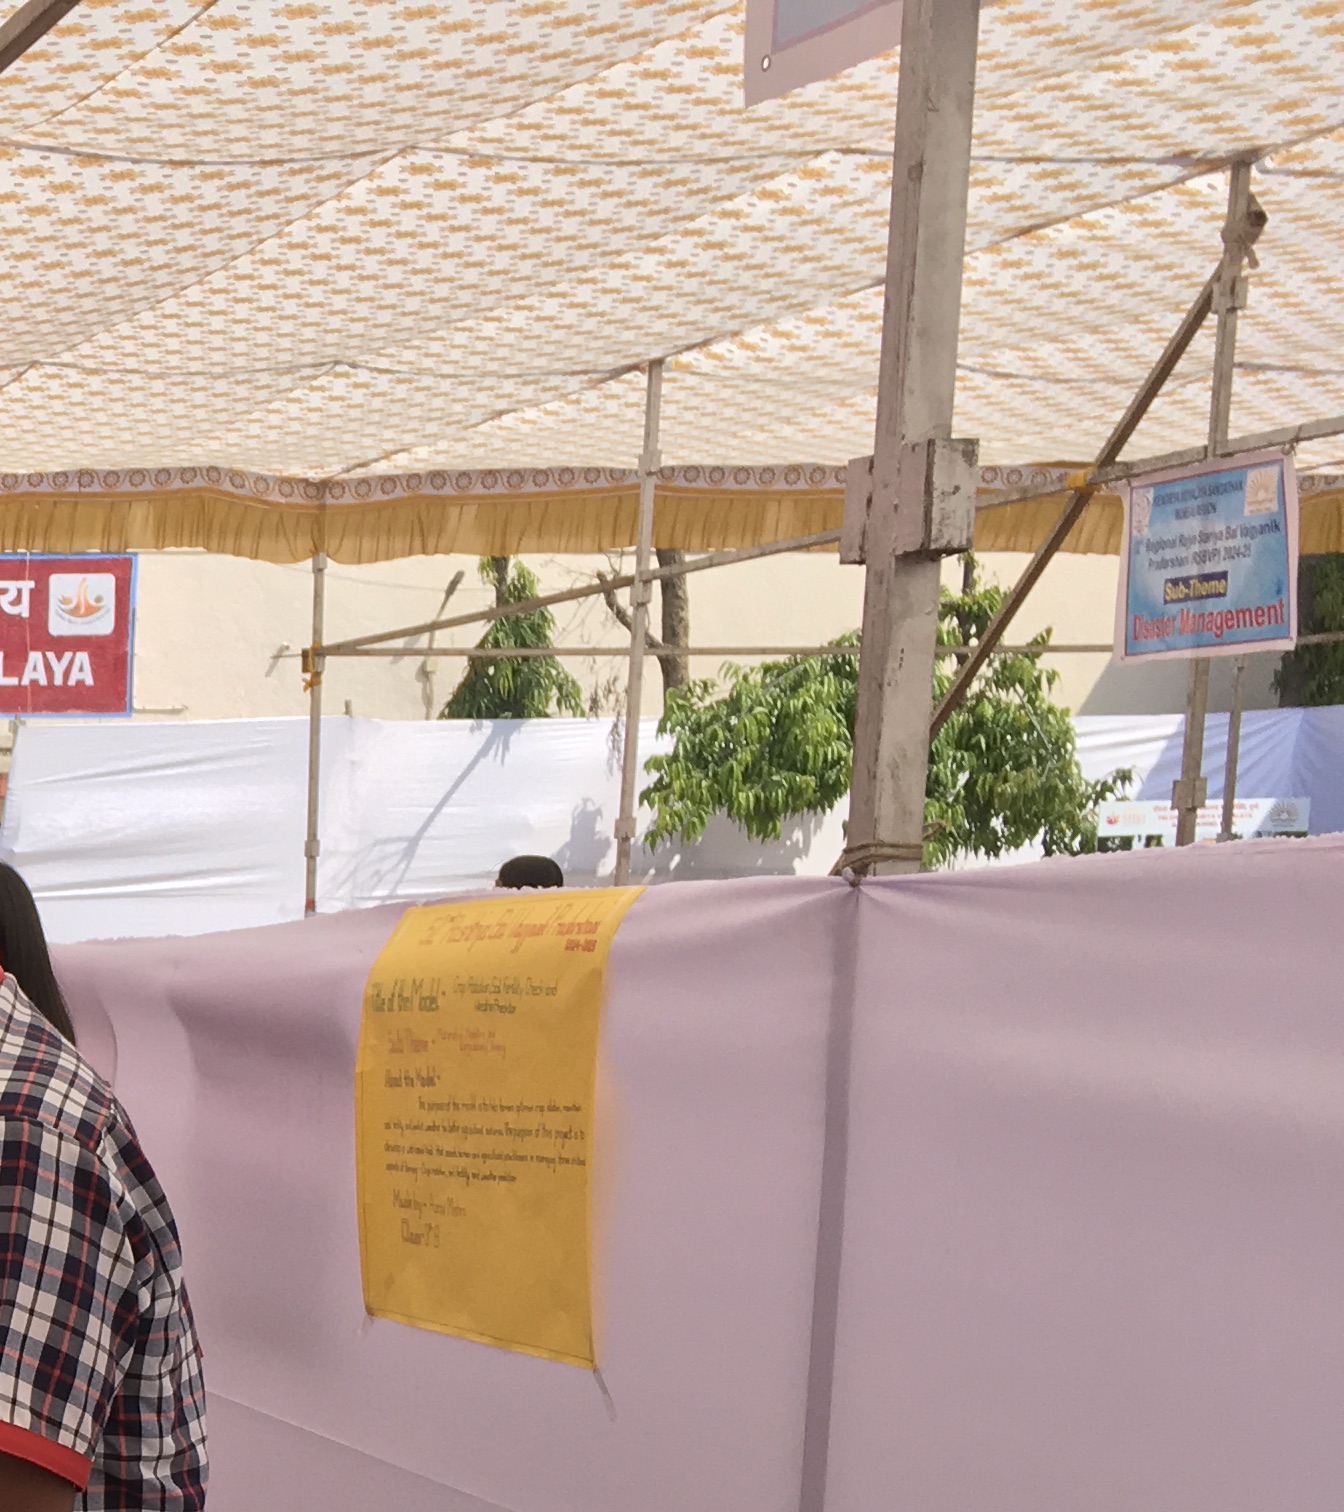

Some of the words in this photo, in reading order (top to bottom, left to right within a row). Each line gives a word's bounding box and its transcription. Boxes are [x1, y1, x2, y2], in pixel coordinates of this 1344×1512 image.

[1165, 576, 1228, 601] Sub-Theme
[1133, 613, 1176, 641] Disaster
[1179, 599, 1285, 639] Management
